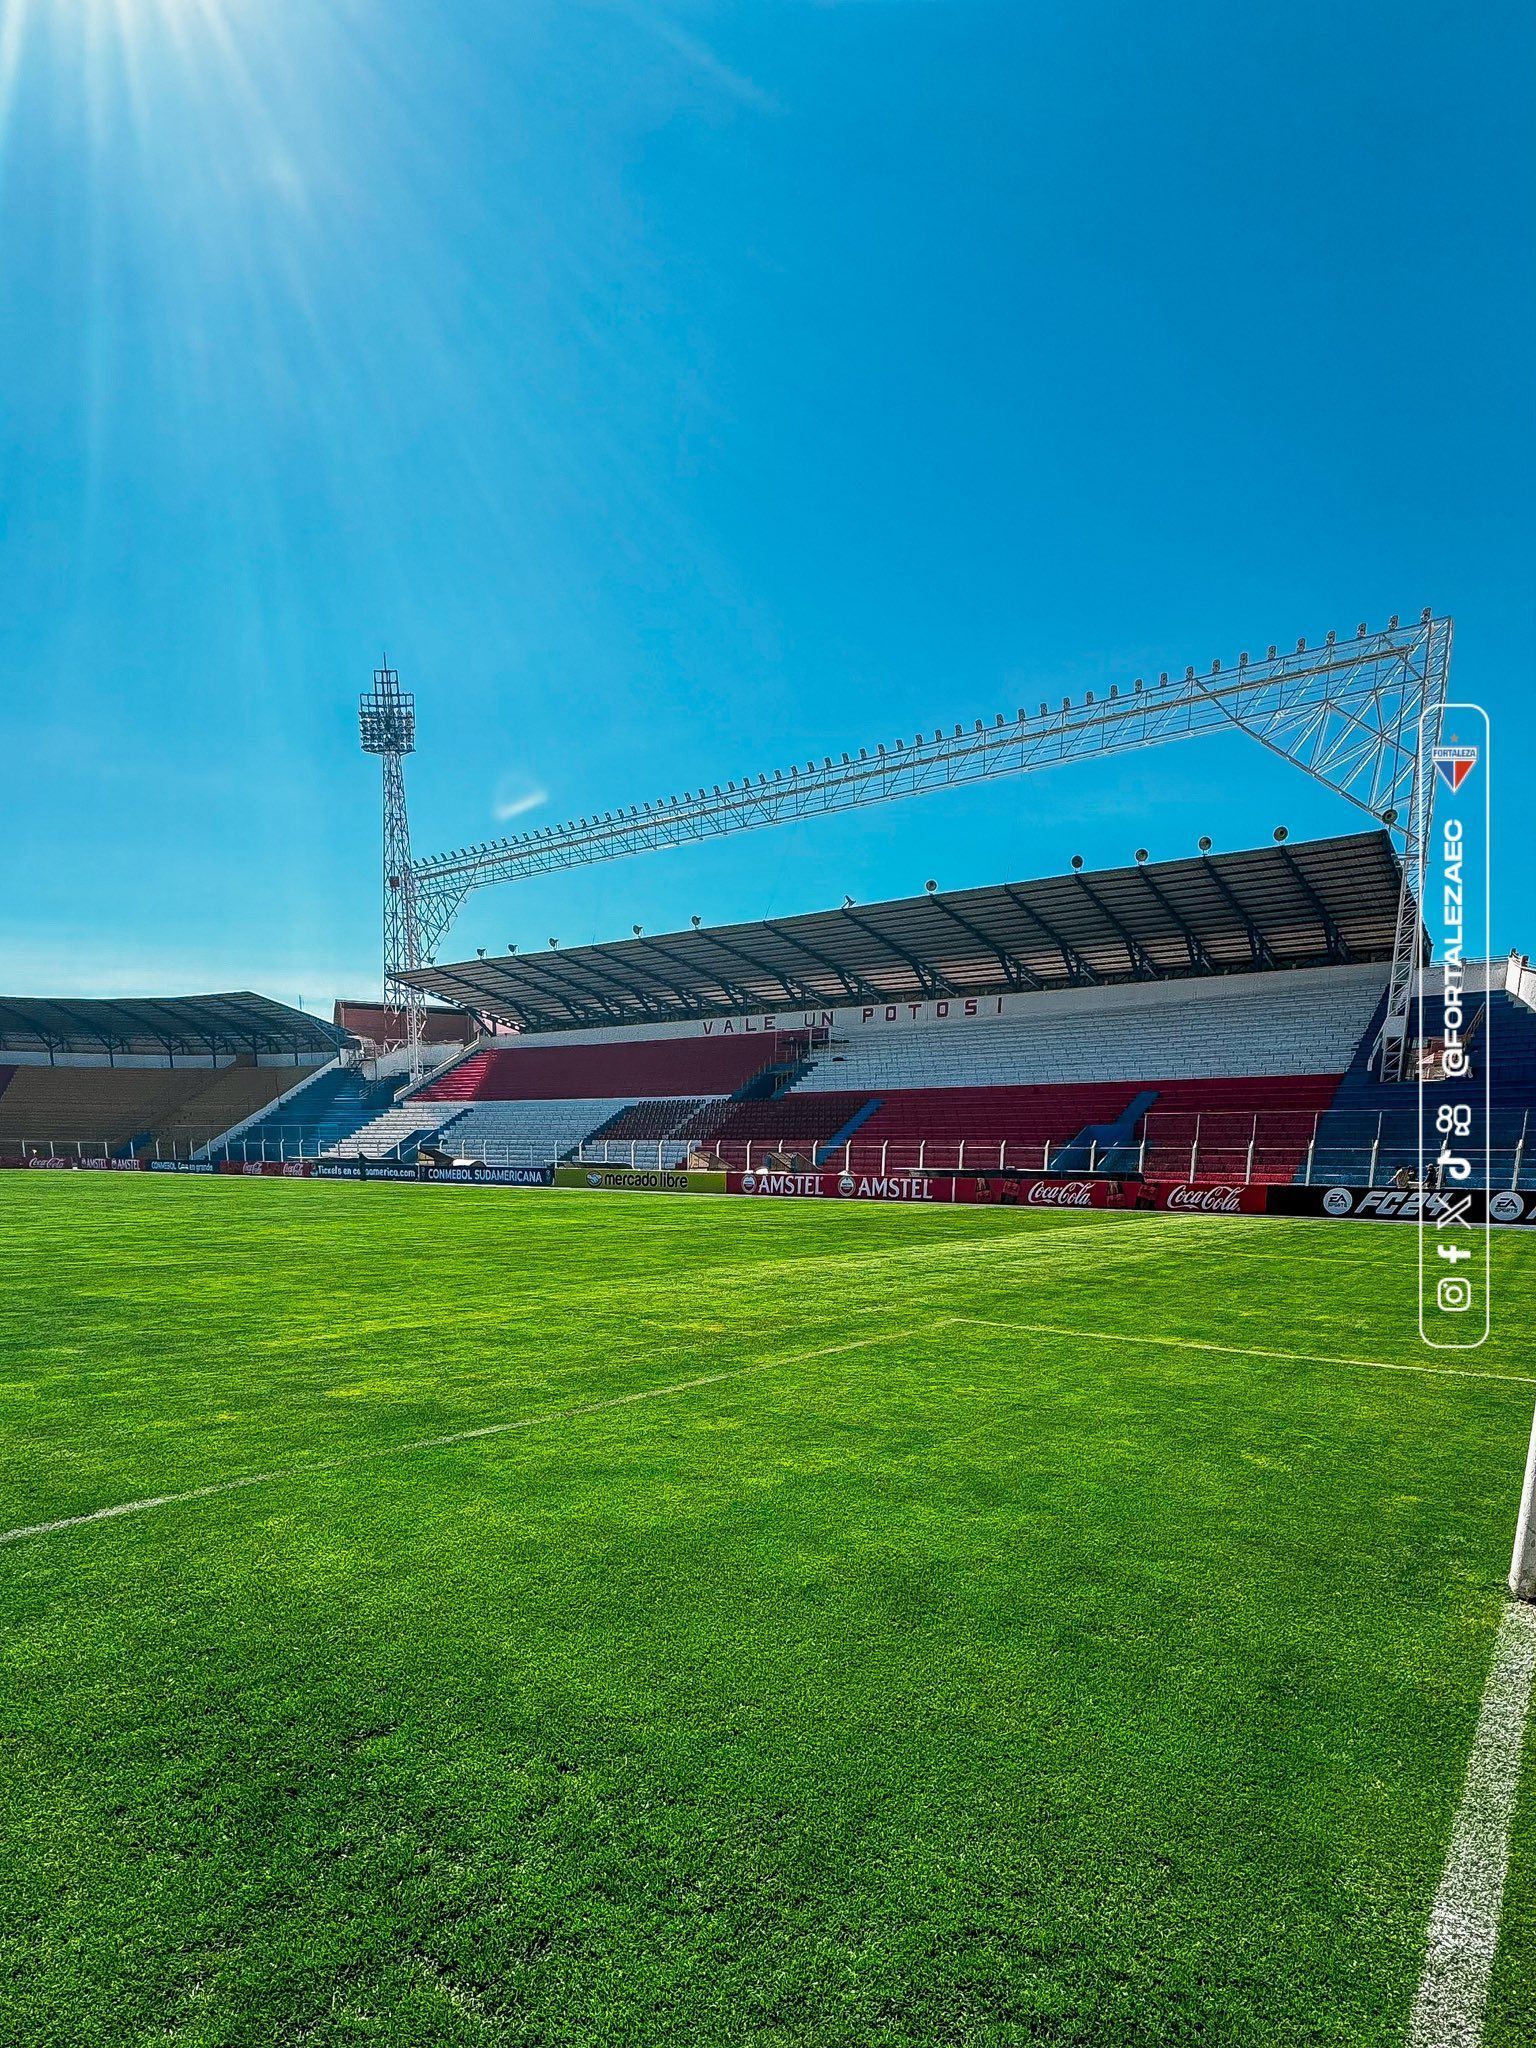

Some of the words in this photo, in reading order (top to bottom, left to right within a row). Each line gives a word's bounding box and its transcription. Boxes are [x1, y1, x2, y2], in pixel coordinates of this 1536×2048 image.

[703, 1015, 776, 1034] VALE
[803, 1010, 834, 1028] UN
[862, 997, 1002, 1024] POTOSI
[116, 1159, 141, 1170] AMSTEL
[343, 1167, 352, 1175] en
[428, 1168, 473, 1180] CONMEBOL
[474, 1170, 543, 1183] SUDAMERICANA
[604, 1173, 658, 1187] mercado
[659, 1173, 688, 1188] libre
[758, 1175, 824, 1195] AMSTEL
[857, 1177, 933, 1199] AMSTEL
[1328, 1193, 1347, 1203] EA
[1496, 1197, 1518, 1208] EA
